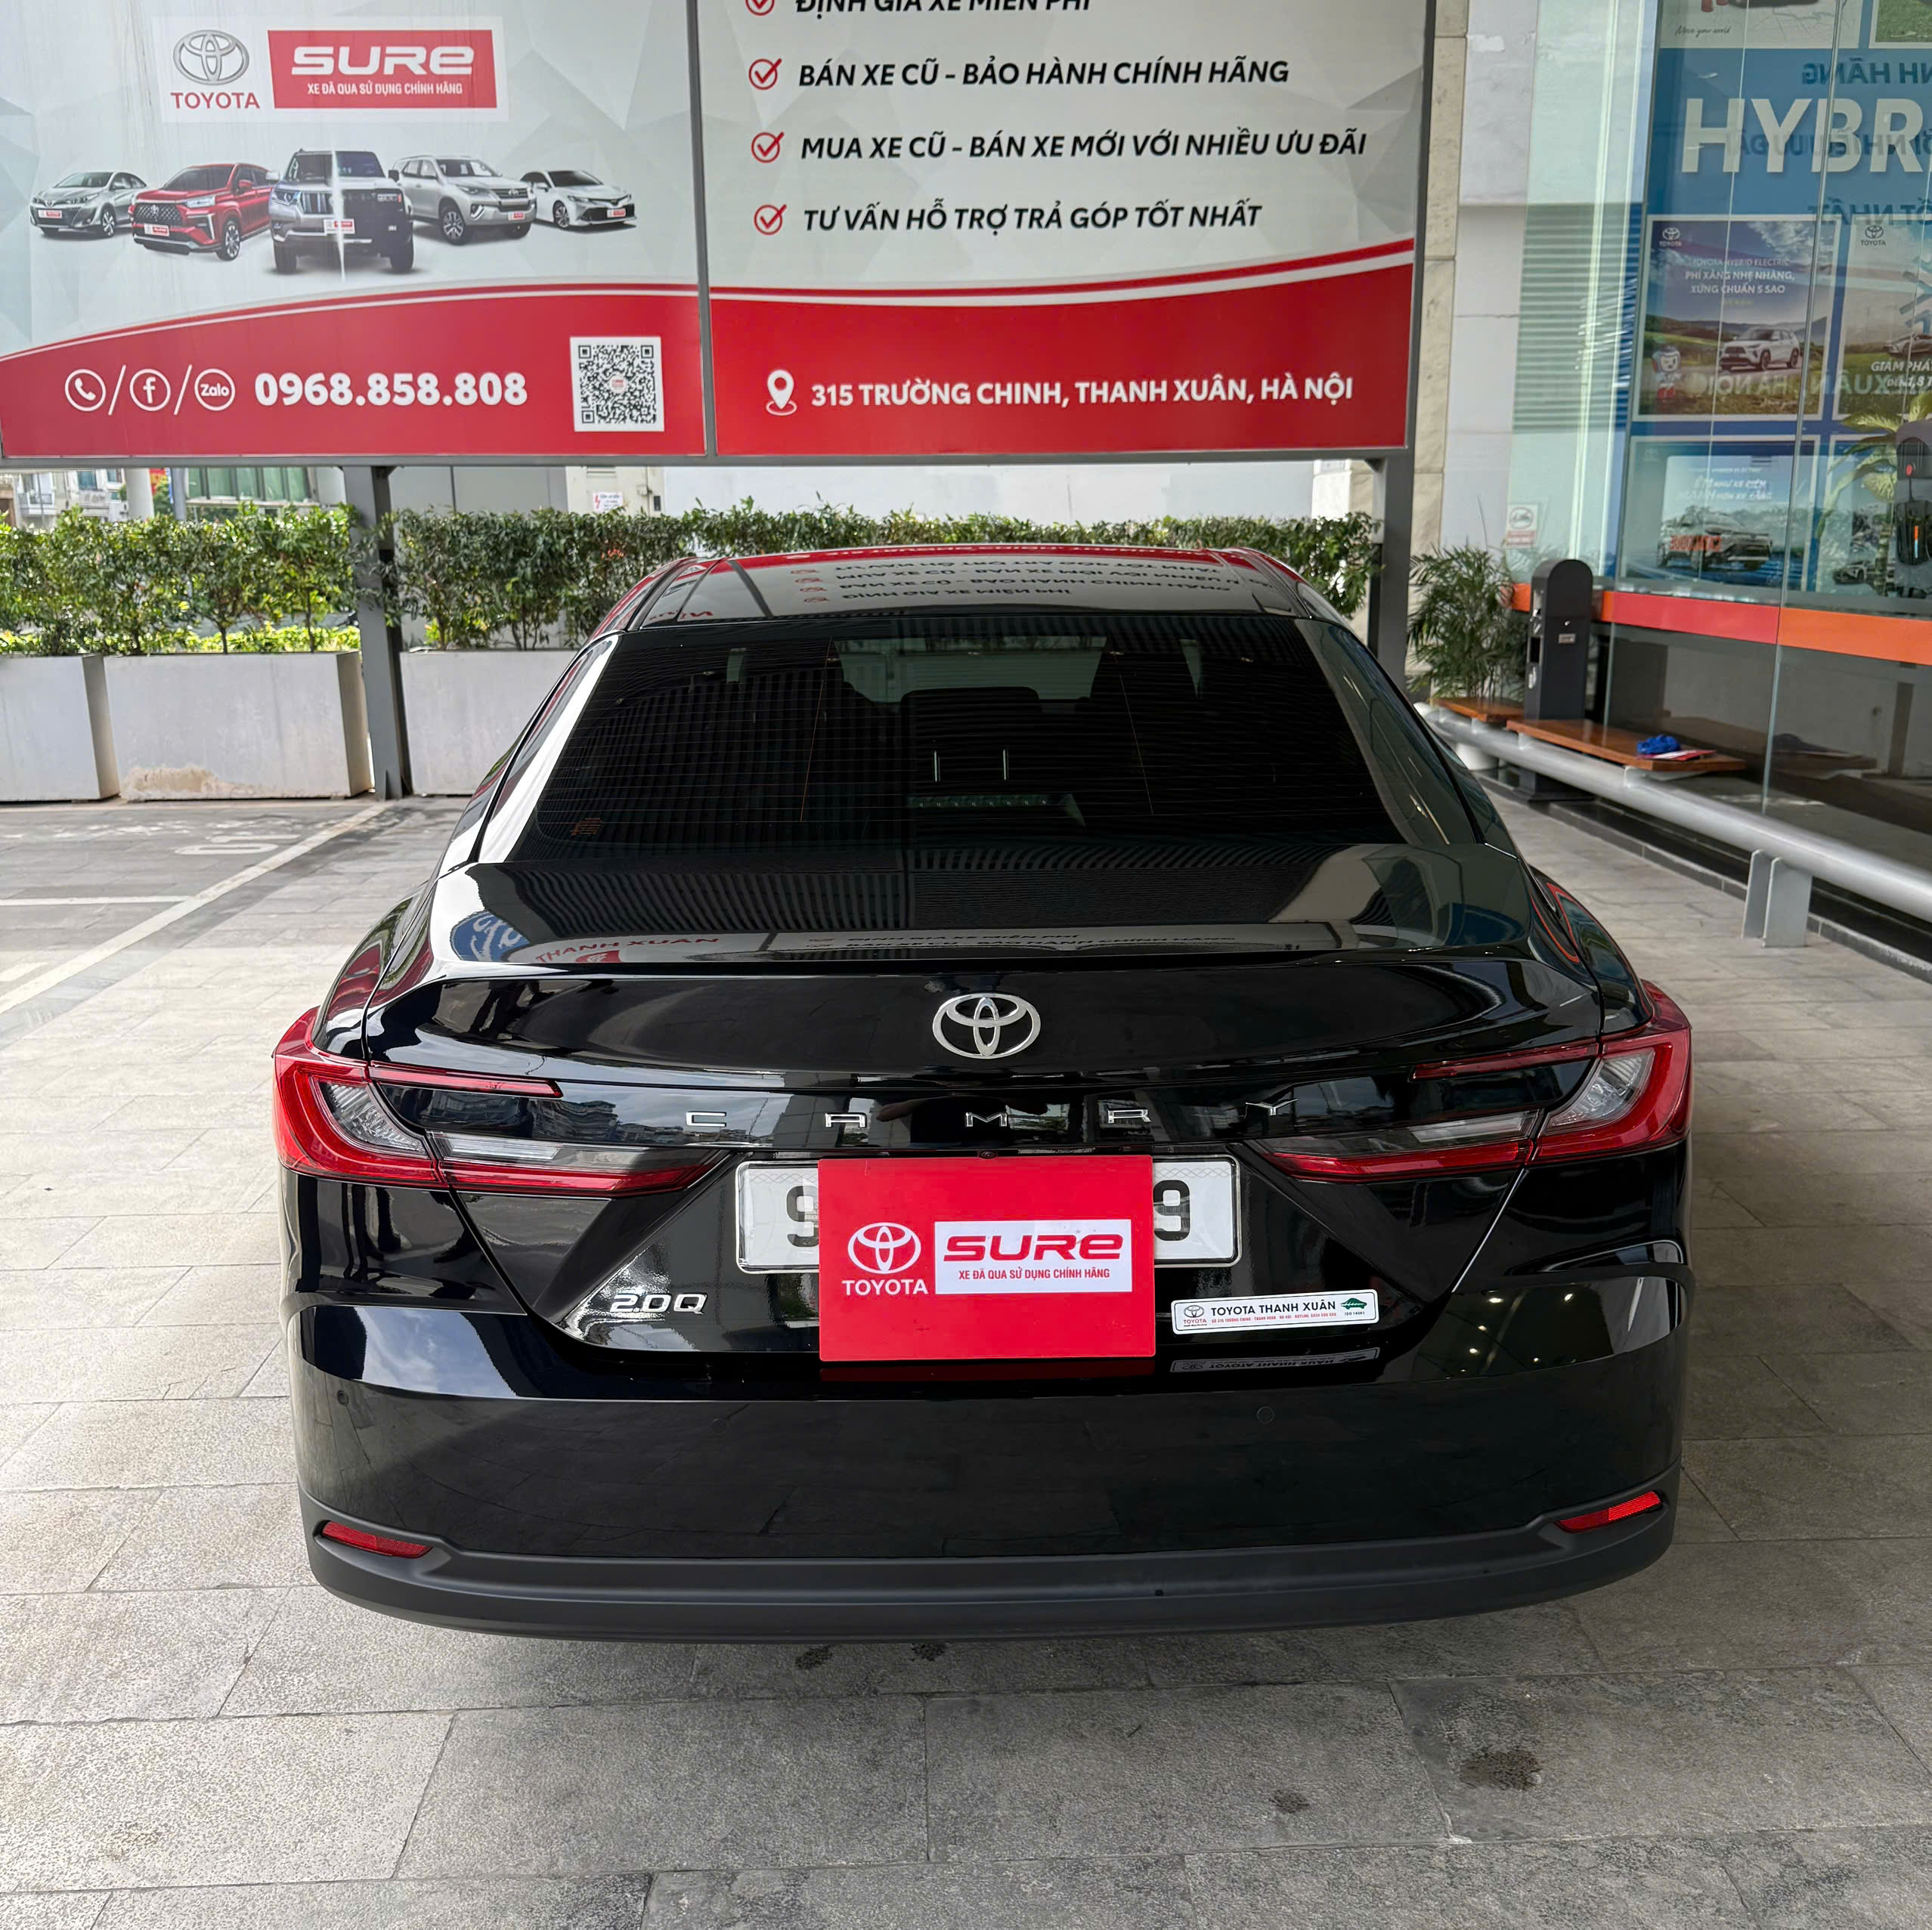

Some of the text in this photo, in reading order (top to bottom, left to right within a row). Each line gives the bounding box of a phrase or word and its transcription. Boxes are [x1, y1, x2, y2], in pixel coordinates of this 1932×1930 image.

[291, 45, 474, 76] SURE
[799, 58, 856, 86] BÁN
[862, 64, 896, 85] XE
[902, 58, 939, 85] CŨ
[962, 56, 1019, 85] BẢO
[1026, 57, 1107, 85] HÀNH
[1113, 56, 1203, 84] CHÍNH
[1209, 56, 1289, 83] HÃNG
[171, 92, 260, 109] TOYOTA
[308, 79, 463, 97] XE ĐÃ QUA SỬ DỤNG CHÍNH HÃNG
[801, 138, 862, 159] MUA
[869, 138, 903, 158] XE
[909, 131, 946, 158] CŨ
[969, 130, 1026, 158] BÁN
[1031, 136, 1065, 158] XE
[1070, 129, 1125, 157] MỚI
[1133, 128, 1178, 156] VỚI
[1185, 126, 1269, 156] NHIỀU
[1276, 130, 1313, 156] ƯU
[1320, 128, 1367, 155] ĐÃI
[804, 198, 1262, 237] TƯ VẤN HỖ TRỢ TRẢ GÓP TỐT NHẤT
[1765, 285, 1785, 294] SAO
[200, 382, 230, 397] Zalo
[255, 371, 528, 407] 0968.858.808
[811, 373, 1354, 408] 315 TRƯỜNG CHINH, THANH XUÂN, HÀ NỘI
[685, 1098, 1299, 1128] CAMRY
[942, 1233, 1124, 1262] SURE
[841, 1279, 928, 1297] TOYOTA
[958, 1267, 1110, 1281] XE ĐÃ QUA SỬ DỤNG CHÍNH HÃNG
[1211, 1299, 1336, 1316] TOYOTA THANH XUÂN
